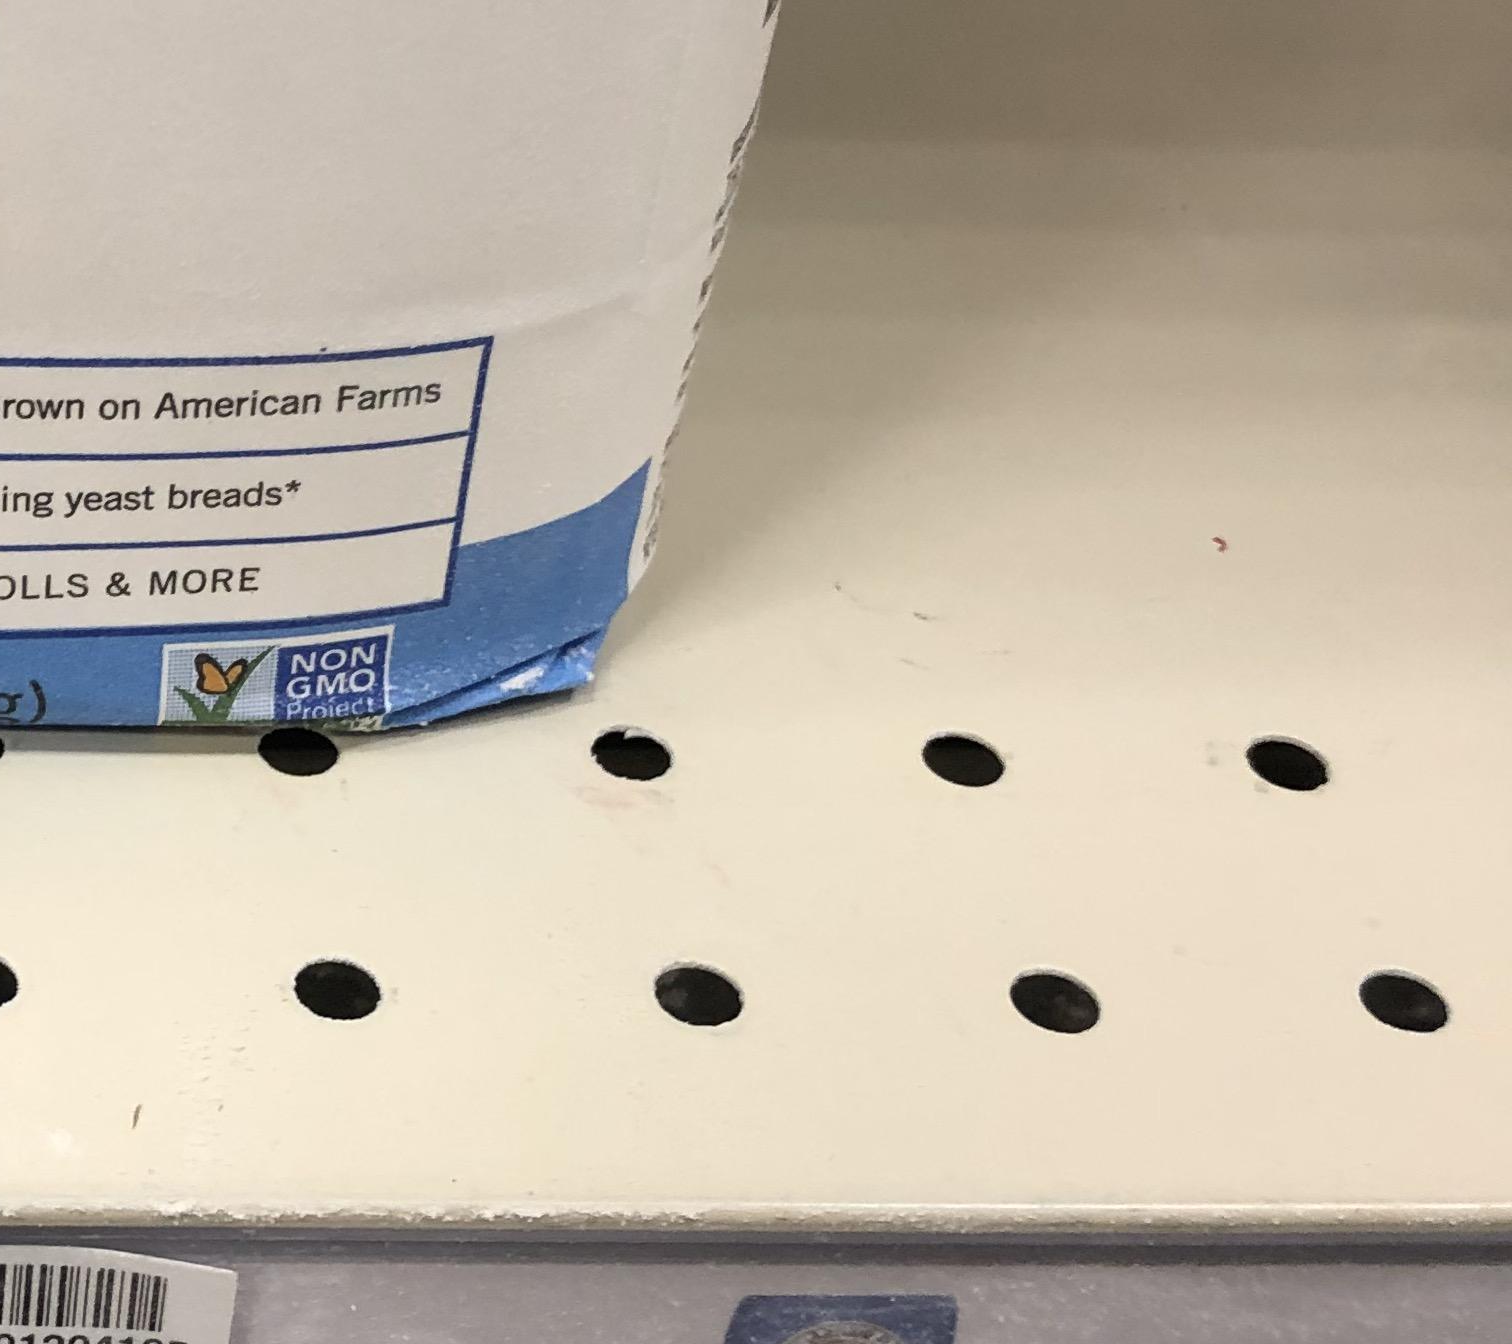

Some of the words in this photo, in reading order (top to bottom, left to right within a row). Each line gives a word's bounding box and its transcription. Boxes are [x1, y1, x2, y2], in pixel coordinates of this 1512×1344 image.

[98, 398, 141, 421] on
[153, 387, 322, 420] American
[335, 378, 442, 414] Farms
[63, 485, 155, 517] yeast
[105, 571, 132, 597] &
[148, 565, 262, 597] MORE
[289, 642, 377, 674] NON
[286, 666, 377, 700] GMO
[287, 697, 376, 721] Project
